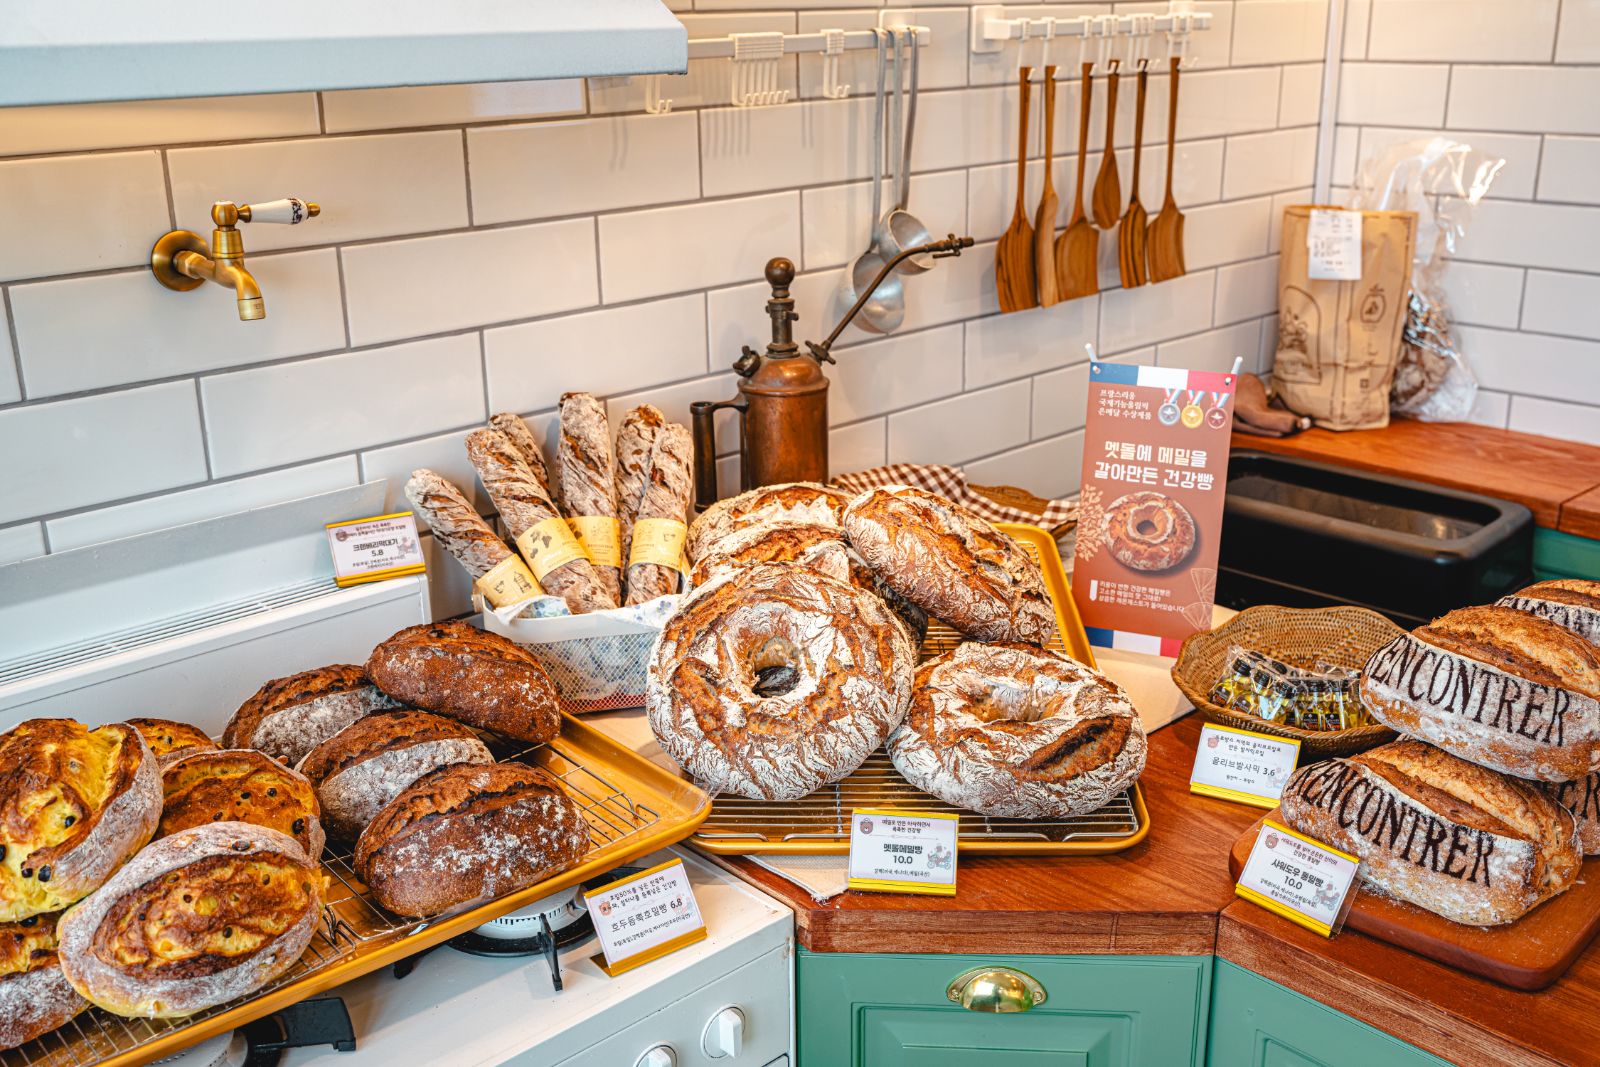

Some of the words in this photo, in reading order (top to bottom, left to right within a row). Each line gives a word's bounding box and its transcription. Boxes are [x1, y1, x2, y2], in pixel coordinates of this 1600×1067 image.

[1104, 440, 1152, 462] 멧돌에
[1157, 446, 1207, 468] 메밀을
[1094, 461, 1158, 485] 갈아만든
[1163, 468, 1214, 490] 건강빵
[1212, 756, 1260, 772] 올리브발사믹
[1262, 767, 1275, 776] 3.6
[883, 843, 922, 853] 멧돌메밀빵
[893, 855, 912, 864] 10.0
[1284, 876, 1302, 889] 10.0
[1300, 871, 1324, 887] 통밀빵
[610, 903, 667, 932] 호두듬뿍호밀빵
[669, 898, 682, 908] 6.8
